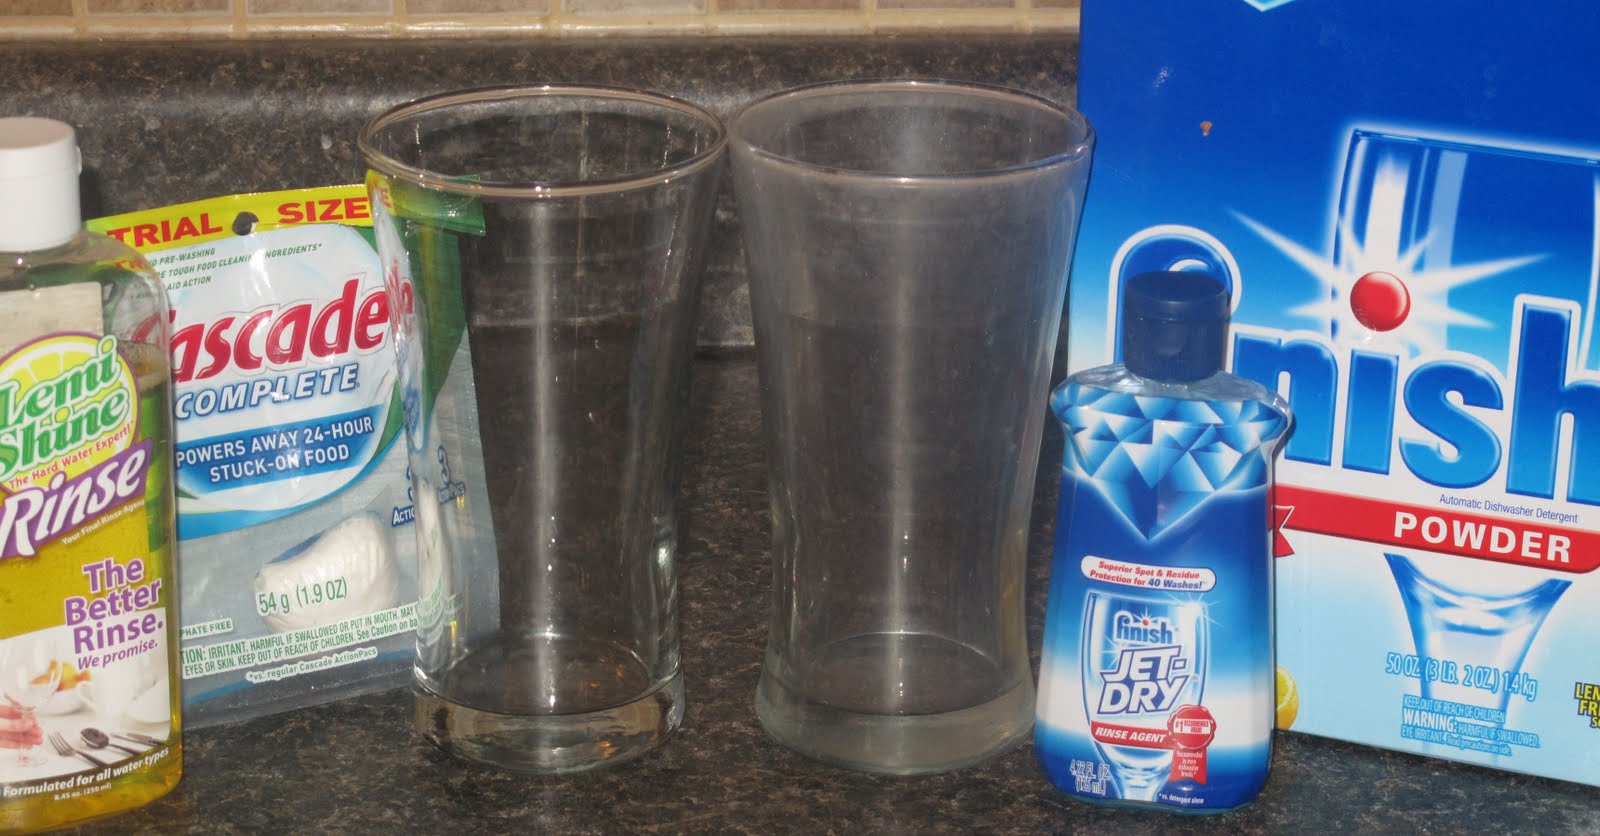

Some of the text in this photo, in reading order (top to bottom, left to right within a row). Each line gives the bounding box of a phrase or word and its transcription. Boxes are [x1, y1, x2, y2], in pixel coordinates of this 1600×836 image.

[107, 213, 223, 247] TRIAL
[277, 197, 370, 223] SIZE
[160, 247, 216, 265] PRE-WASHING
[169, 265, 195, 277] TOUGH
[197, 260, 217, 272] FOOD
[265, 243, 323, 258] NGREDIENTS
[167, 275, 212, 291] AID ACTION
[0, 337, 119, 430] Lemi
[175, 363, 359, 420] COMPLETE
[0, 393, 127, 477] Shine
[176, 416, 374, 467] POWERS AWAY 24-HOUR
[9, 425, 131, 489] The Hard Water Expert!
[210, 444, 350, 483] STUCK-ON FOOD
[0, 448, 146, 558] Rinse
[1439, 494, 1578, 524] Automatic Dishwasher Detergent
[62, 534, 80, 545] Your
[81, 521, 101, 536] Final
[1394, 511, 1571, 564] POWDER
[83, 559, 144, 592] The
[1090, 570, 1132, 584] Protection
[1134, 577, 1147, 586] for
[1148, 578, 1160, 587] 40
[1098, 561, 1200, 579] Superior Spot & Residue
[65, 579, 161, 626] Better
[258, 576, 348, 613] 54 g (1.9 OZ)
[73, 612, 163, 654] Rinse.
[208, 641, 249, 659] IRRITANT.
[250, 635, 285, 652] HARMFUL
[286, 634, 293, 644] IF
[295, 624, 338, 642] SWALLOWED
[340, 622, 349, 633] OR
[351, 618, 363, 629] PUT
[365, 616, 373, 626] IN
[374, 611, 400, 624] MOUTH.
[400, 607, 415, 618] MAY
[210, 620, 232, 632] FREE
[1115, 613, 1174, 645] finish
[77, 642, 158, 671] We promise.
[185, 665, 204, 676] EYES
[205, 662, 217, 672] OR
[218, 659, 237, 670] SKIN.
[239, 654, 256, 666] KEEP
[258, 650, 272, 661] OUT
[274, 647, 283, 658] OF
[285, 643, 309, 657] REACH
[310, 640, 319, 651] OF
[357, 630, 370, 640] See
[371, 623, 398, 637] Caution
[400, 621, 408, 630] on
[268, 666, 298, 678] regular
[300, 657, 333, 671] Cascade
[335, 647, 377, 663] ActionPacs
[1098, 675, 1190, 714] DRY
[1386, 652, 1401, 675] 50
[1424, 657, 1439, 682] (3
[1463, 664, 1473, 688] 2
[1502, 671, 1521, 694] 1.4
[1521, 673, 1537, 702] kg
[1095, 726, 1167, 743] RINSE AGENT
[1403, 708, 1457, 733] WARNING:
[3, 747, 169, 797] Formulated for all water types
